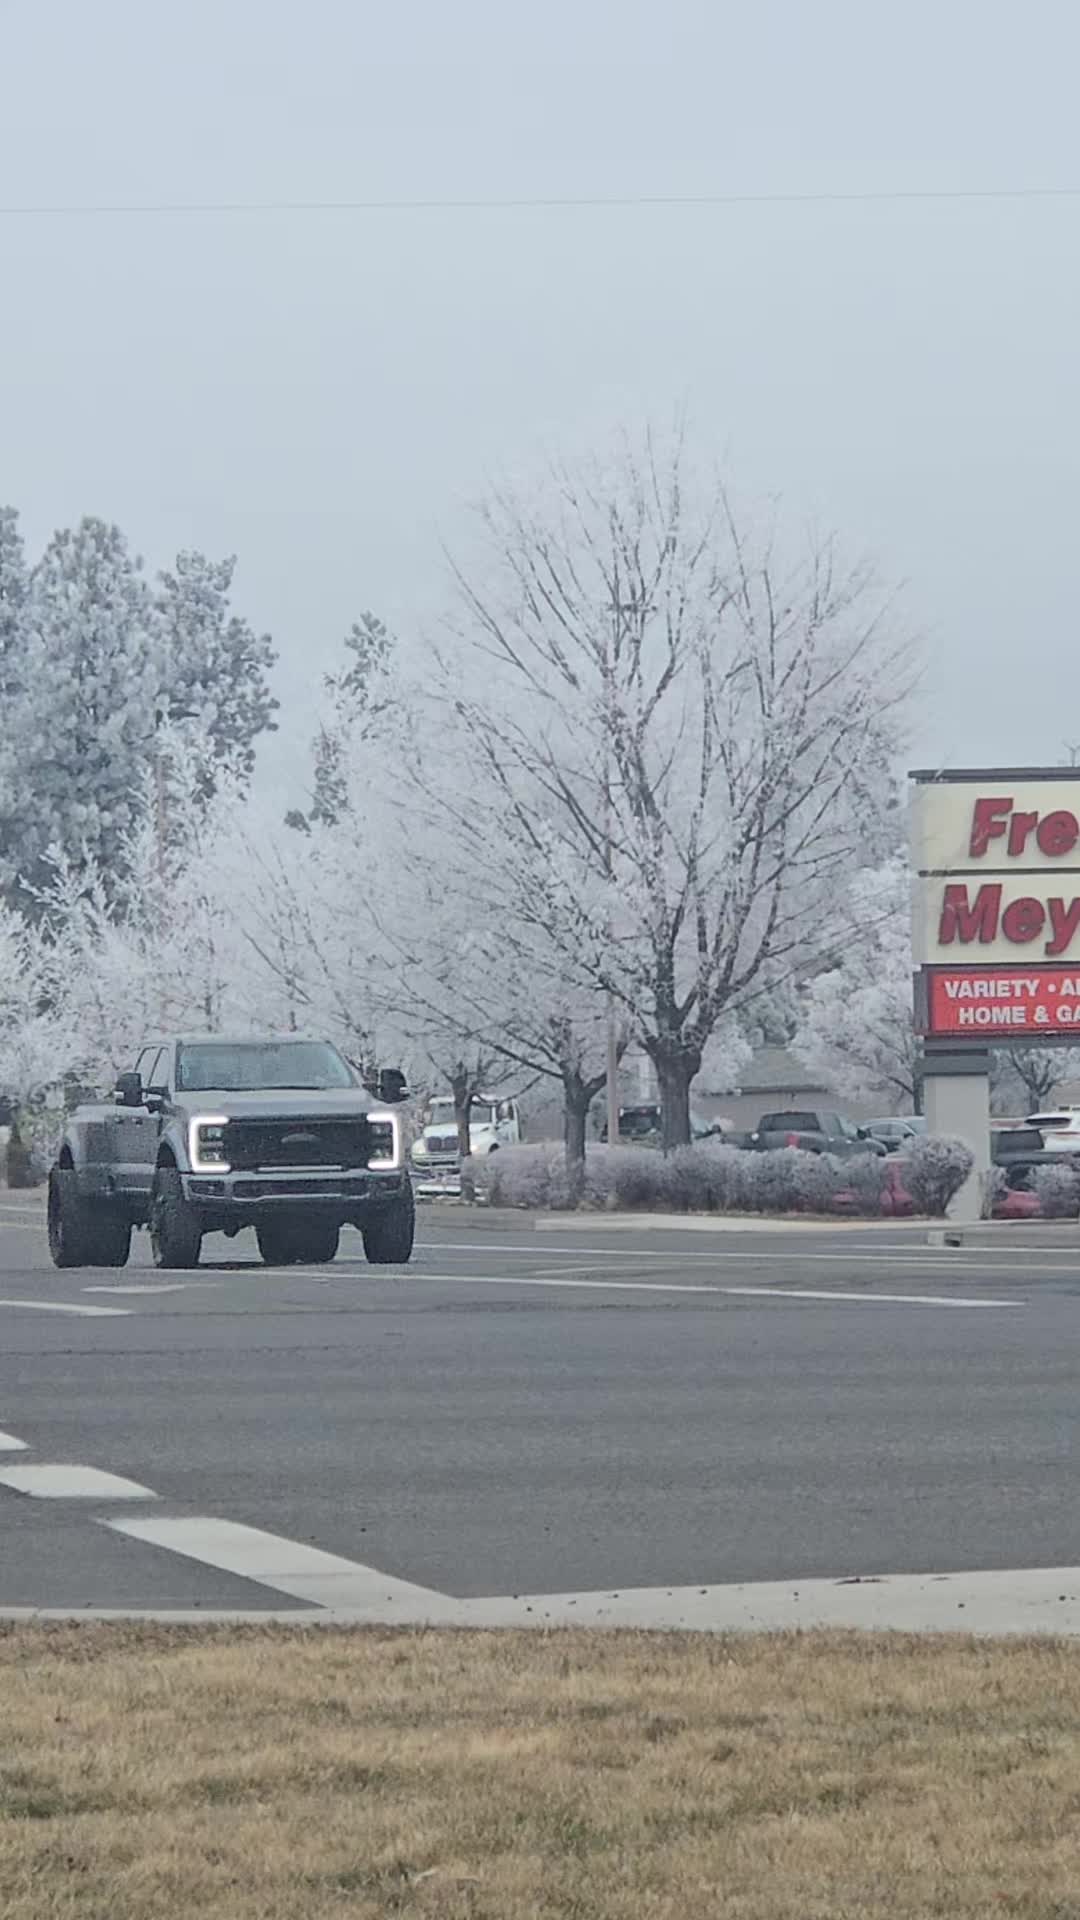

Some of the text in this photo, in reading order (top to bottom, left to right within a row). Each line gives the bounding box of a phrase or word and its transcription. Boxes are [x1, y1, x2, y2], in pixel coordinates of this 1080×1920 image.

[969, 797, 1079, 858] Fre
[938, 883, 1080, 956] Mey
[944, 979, 1040, 998] VARIETY
[959, 1006, 1027, 1025] HOME
[1034, 1005, 1050, 1024] &
